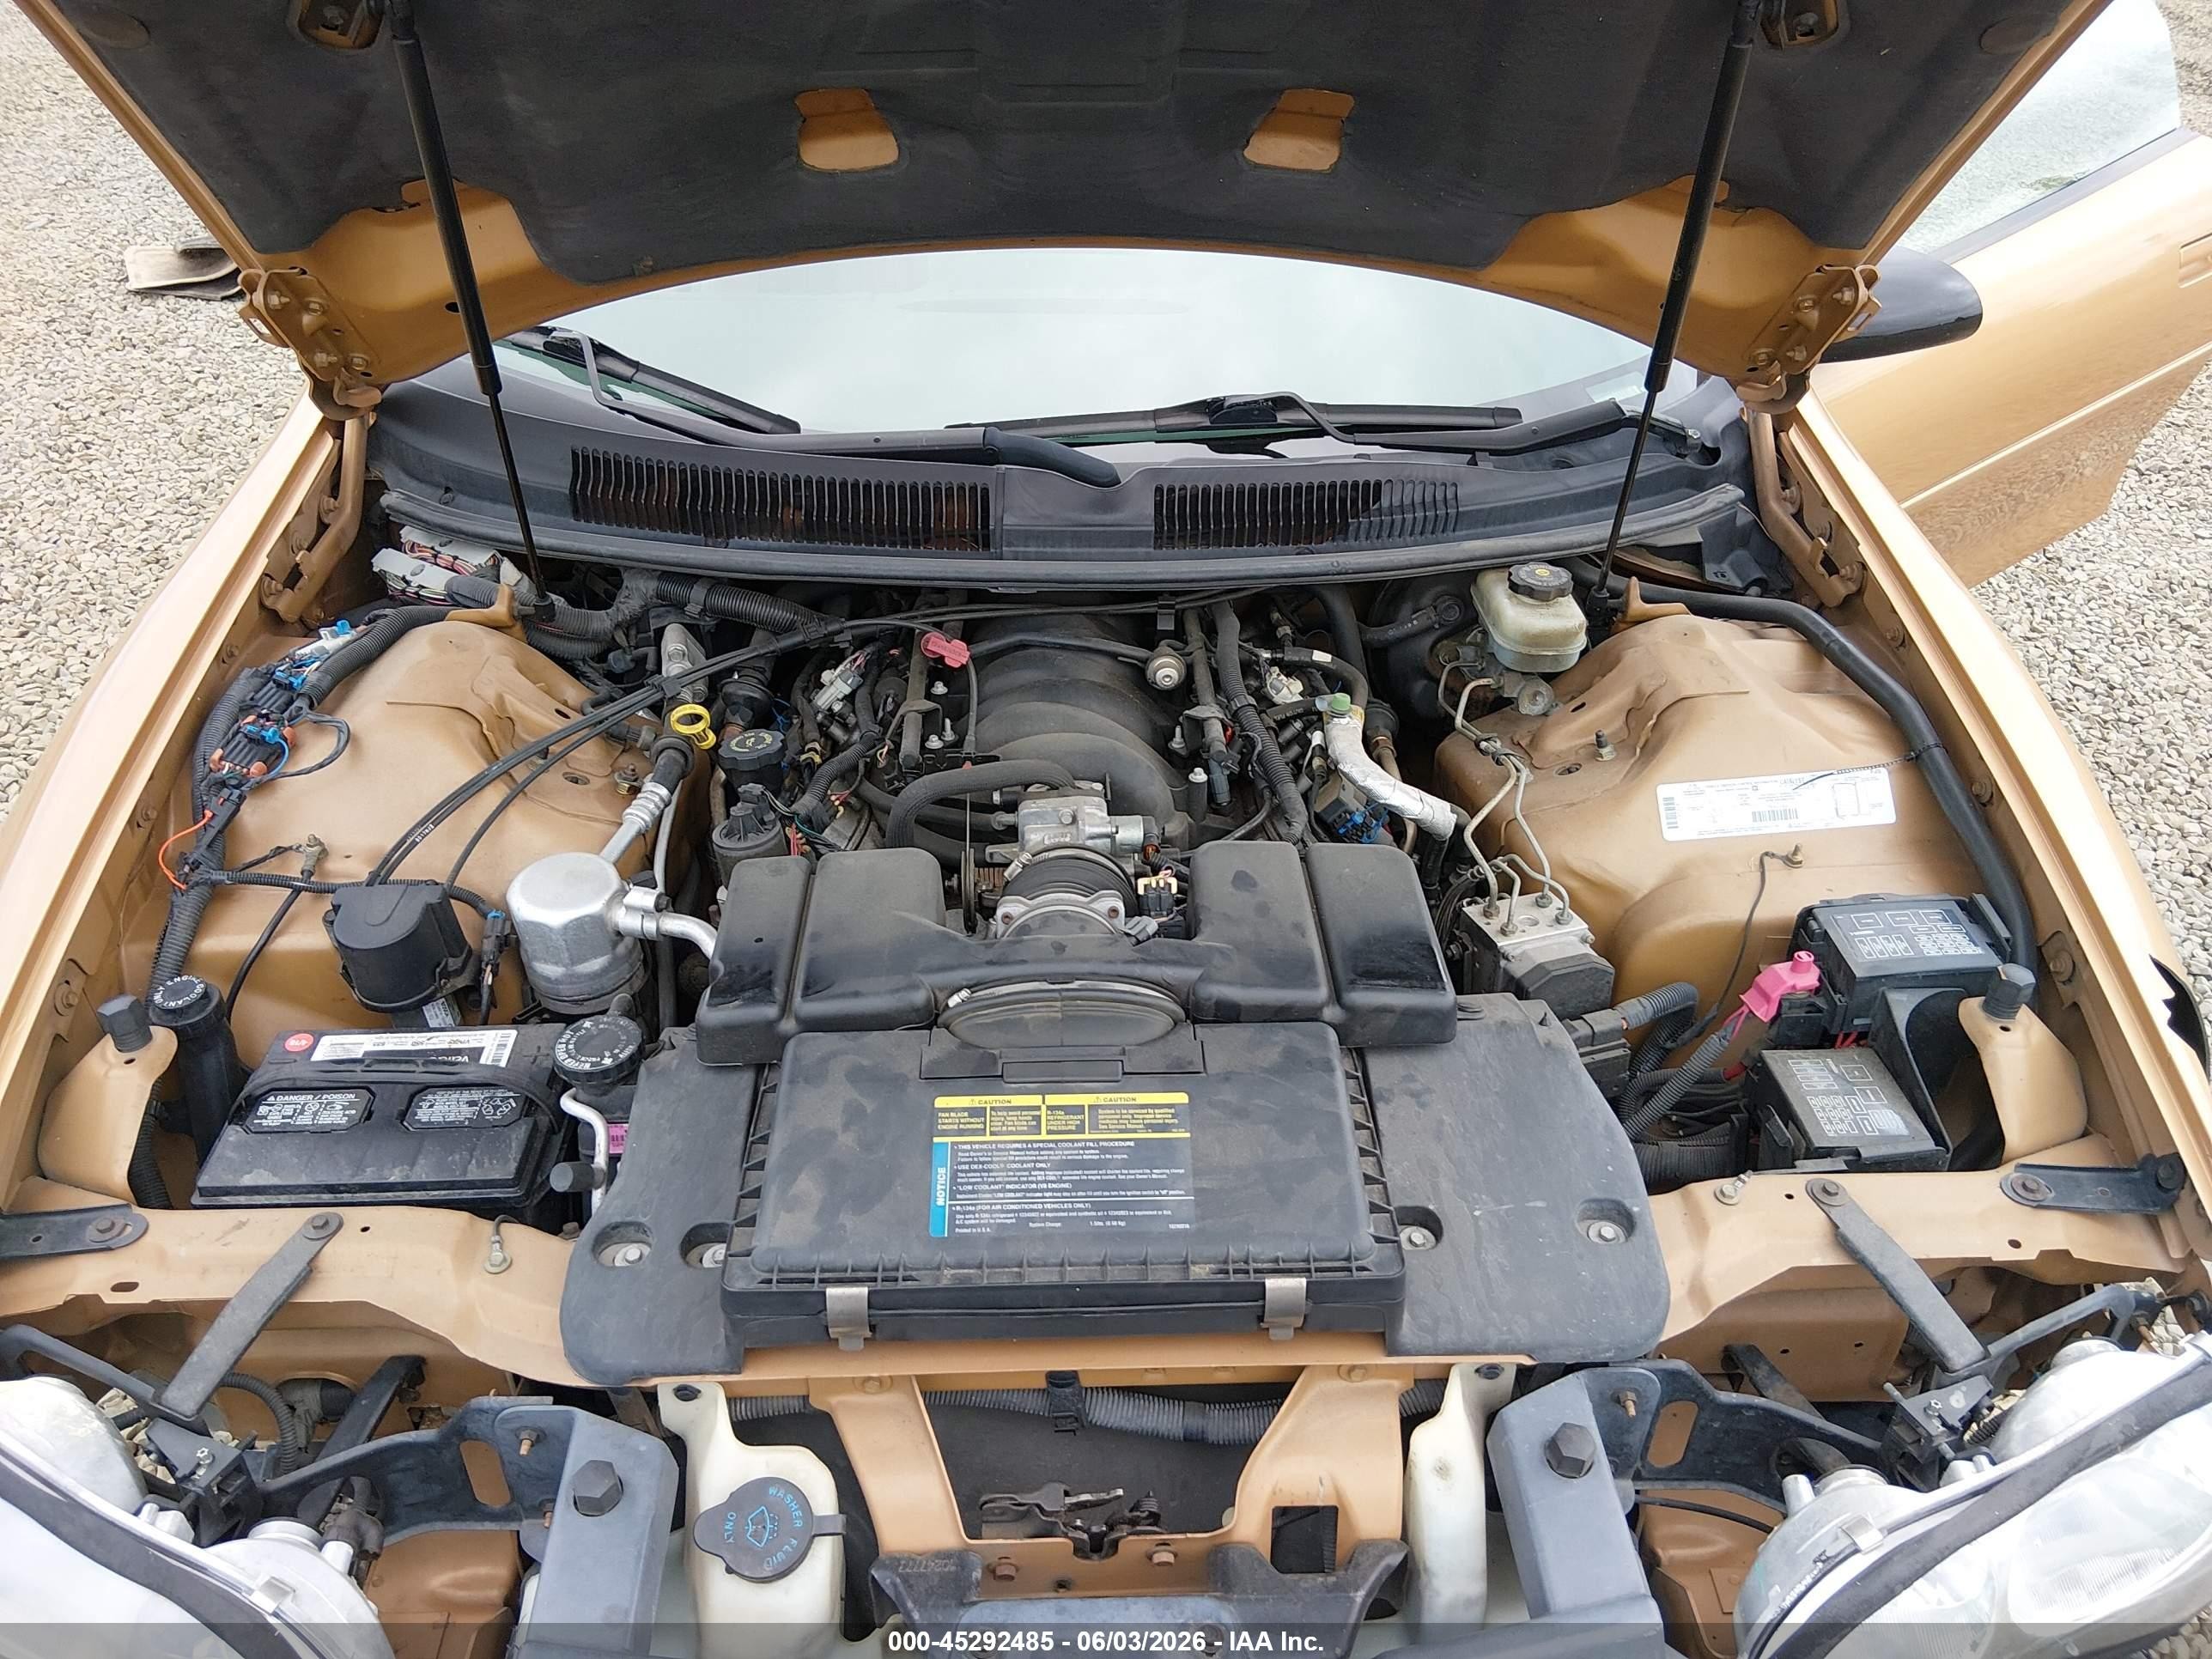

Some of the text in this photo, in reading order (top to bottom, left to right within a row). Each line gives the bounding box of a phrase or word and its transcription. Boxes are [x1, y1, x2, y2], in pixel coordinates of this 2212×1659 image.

[154, 975, 204, 1006] ENGINE COOLANT ONLY
[558, 1030, 574, 1042] HOT
[936, 1166, 946, 1206] NOTICE
[724, 1486, 803, 1571] WASHER FLUID ONLY
